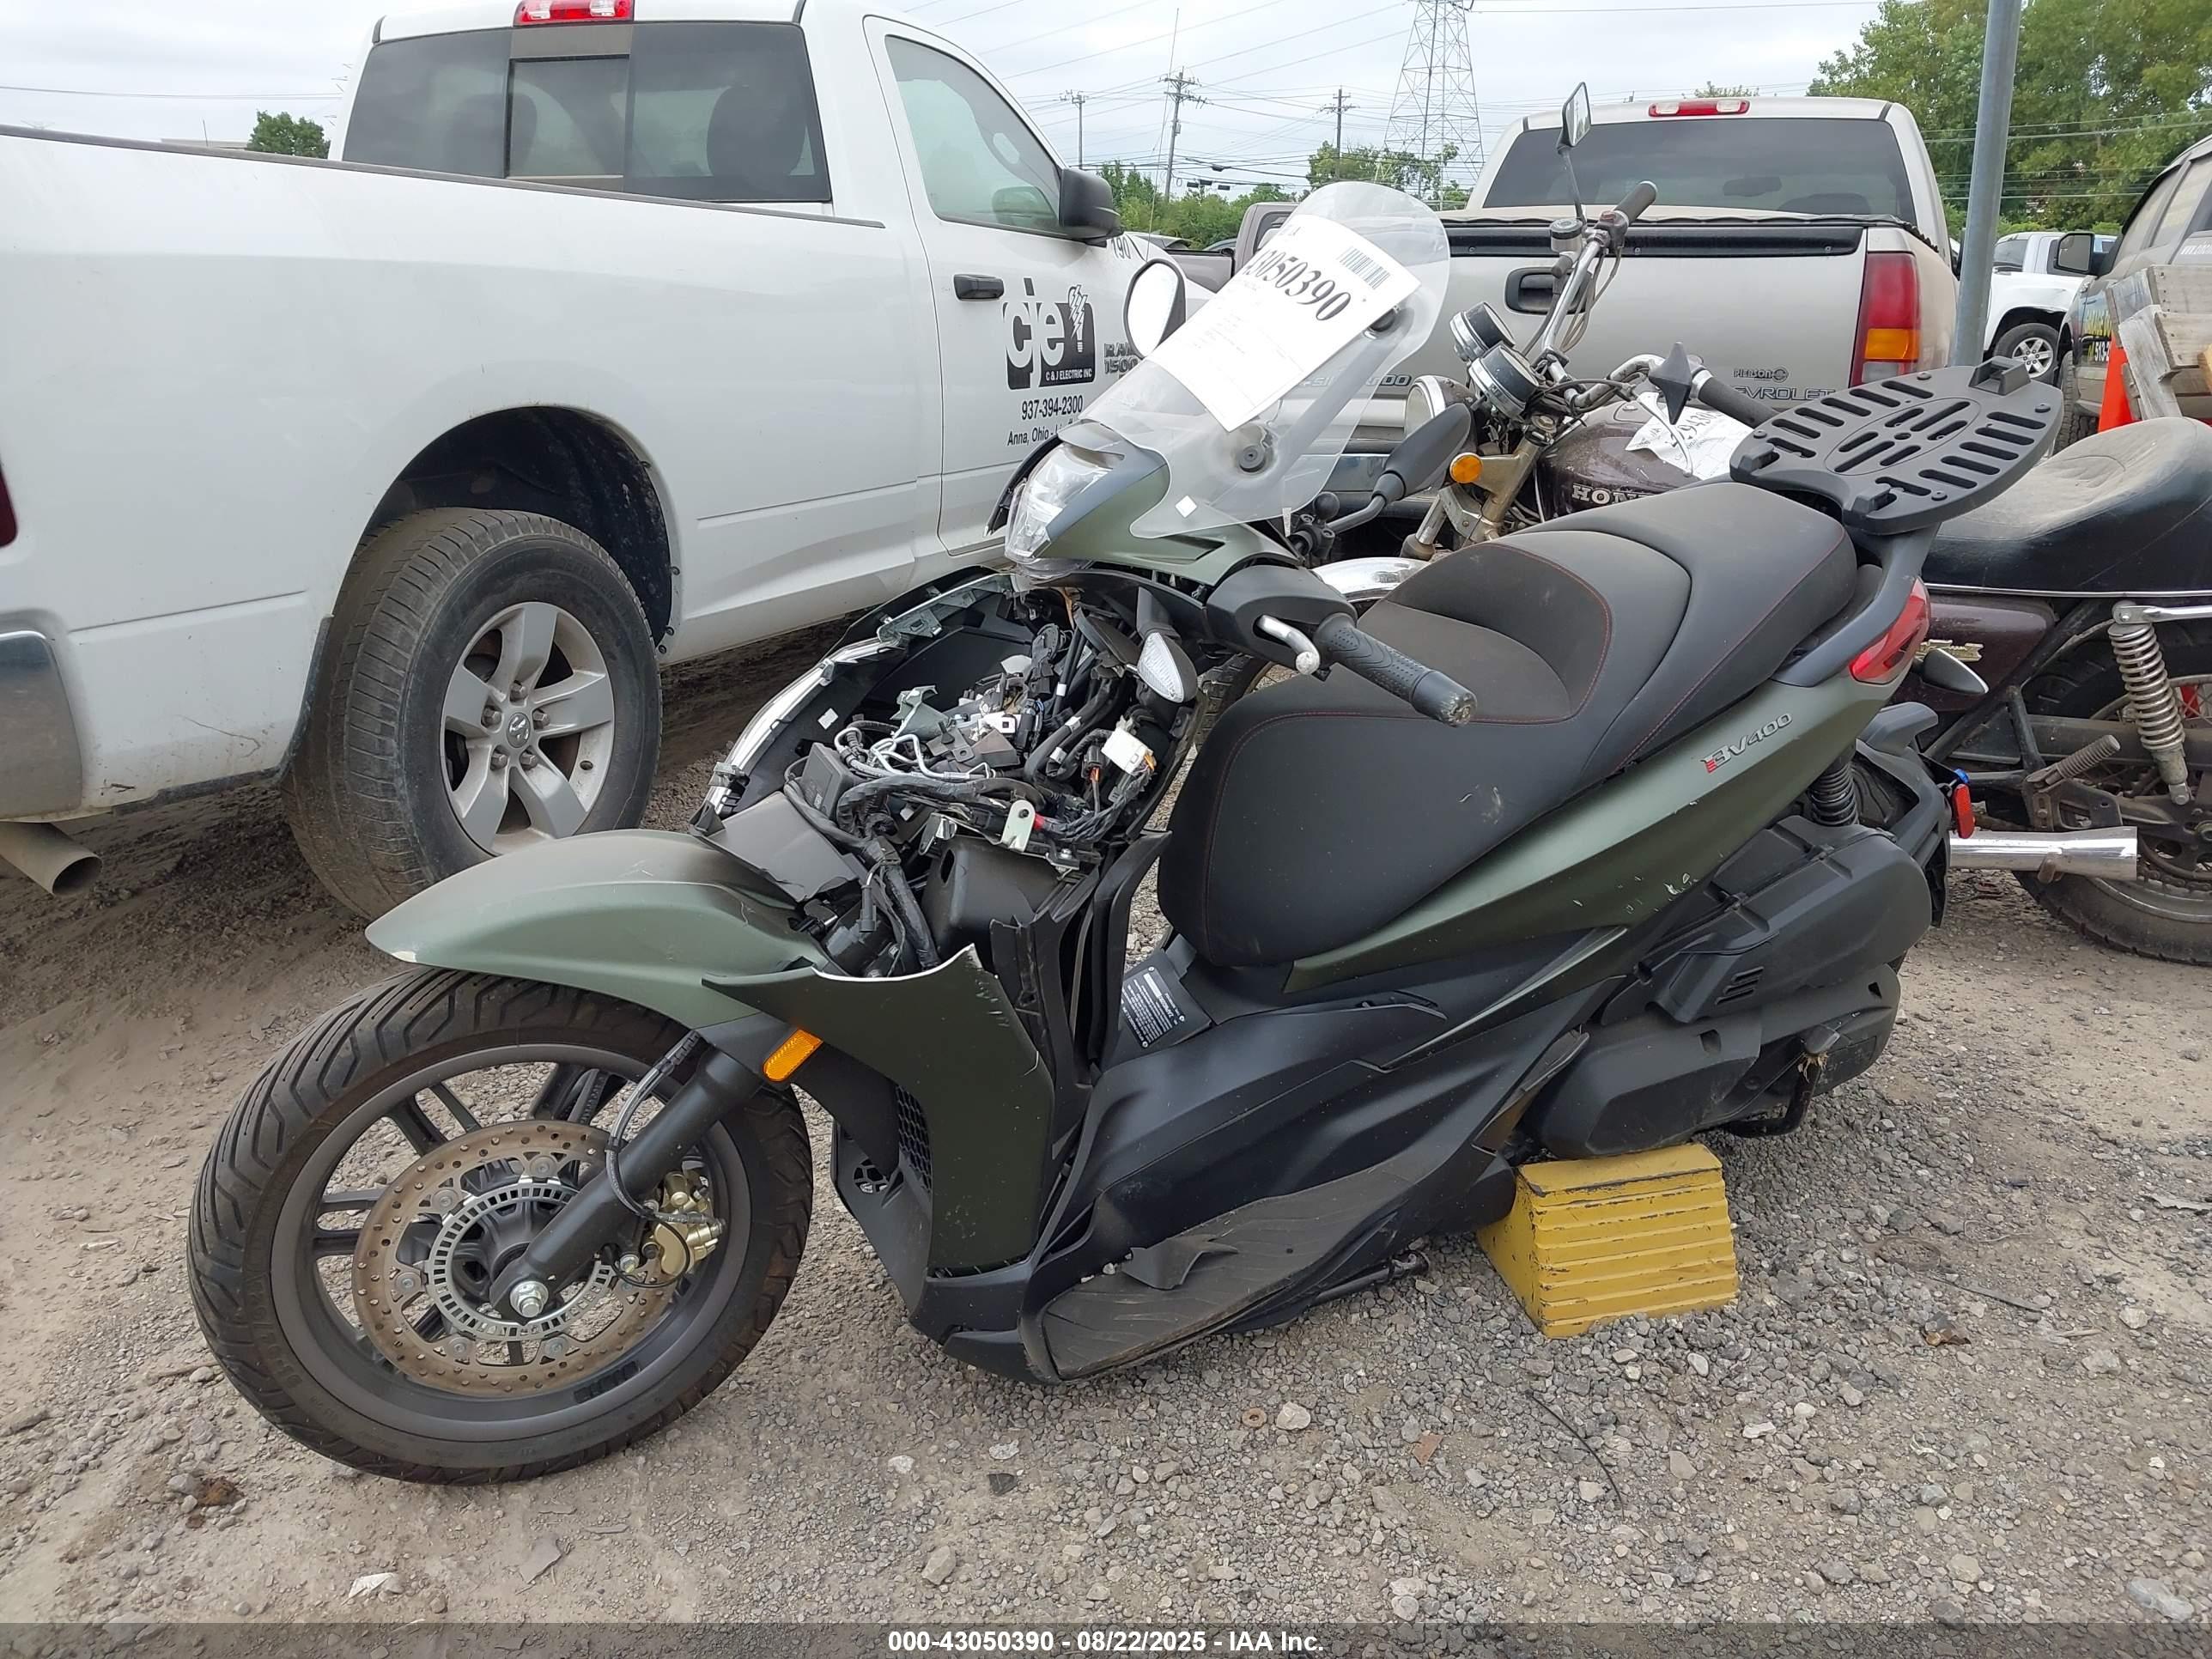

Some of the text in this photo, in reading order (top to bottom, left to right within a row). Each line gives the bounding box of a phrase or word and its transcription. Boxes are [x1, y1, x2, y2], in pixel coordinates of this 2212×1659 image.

[1045, 372, 1050, 380] C
[1059, 369, 1083, 380] ELECTRIC
[1083, 368, 1092, 378] INC
[1021, 395, 1084, 420] 937-394-2300
[1007, 430, 1030, 447] Anna,
[1031, 427, 1049, 442] Ohio
